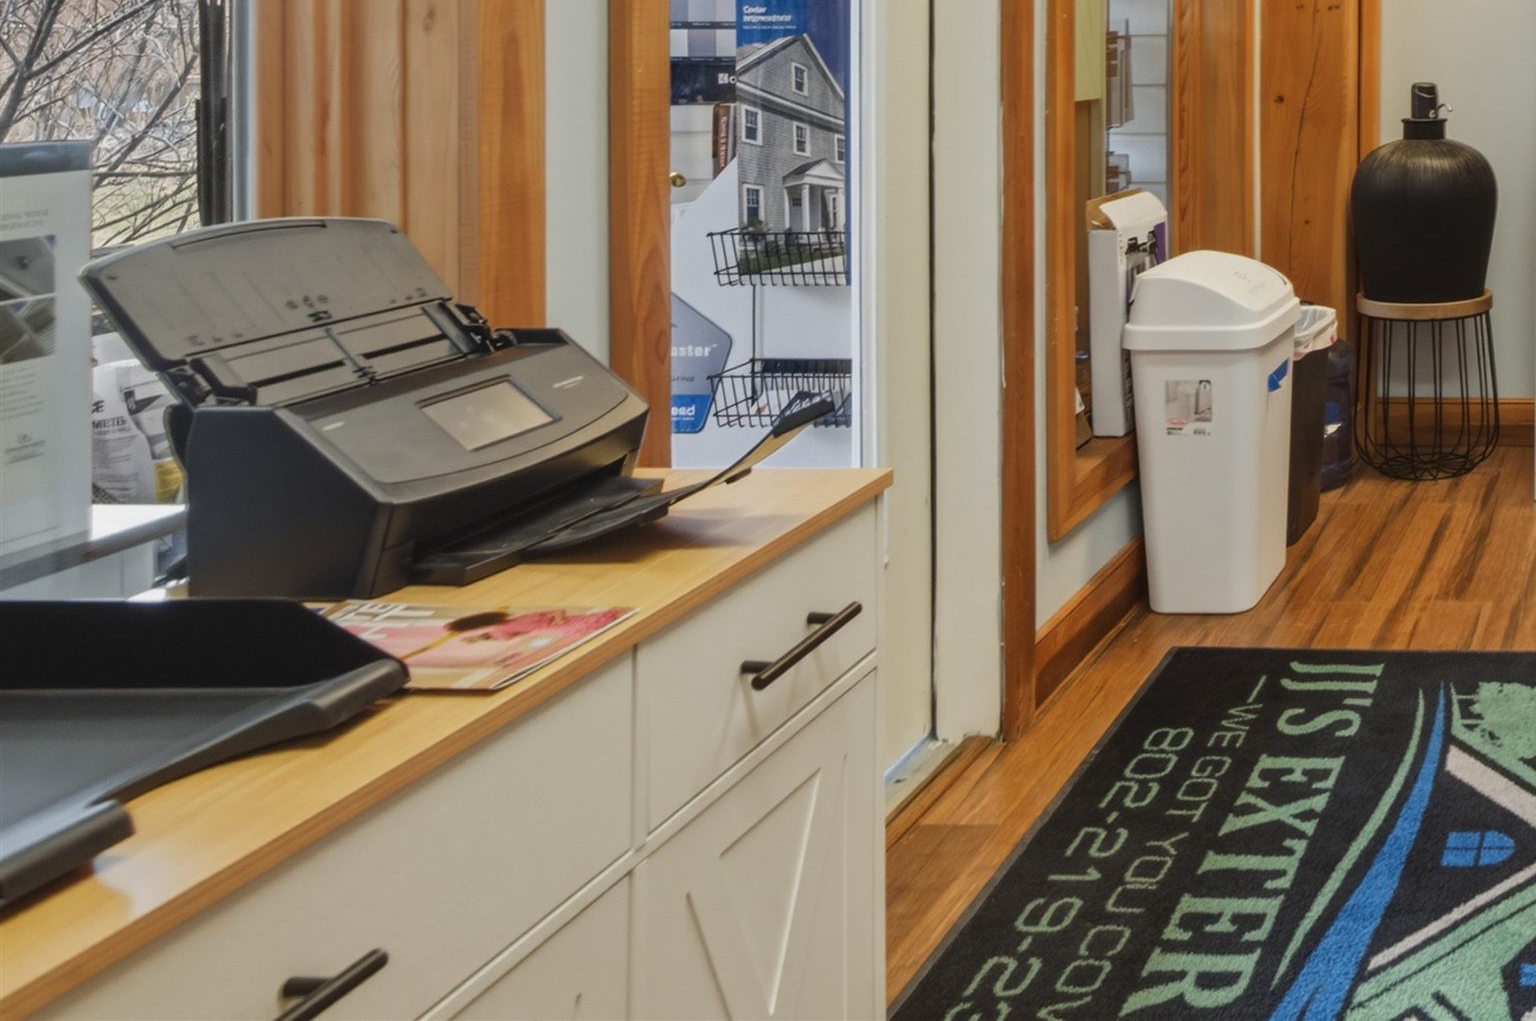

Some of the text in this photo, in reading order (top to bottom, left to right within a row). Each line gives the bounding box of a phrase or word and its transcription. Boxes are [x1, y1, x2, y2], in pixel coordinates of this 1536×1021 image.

[1207, 703, 1263, 748] WE
[1166, 755, 1232, 823] GOT
[1105, 832, 1189, 913] YOU
[1119, 661, 1385, 1017] JJ'S EXTER
